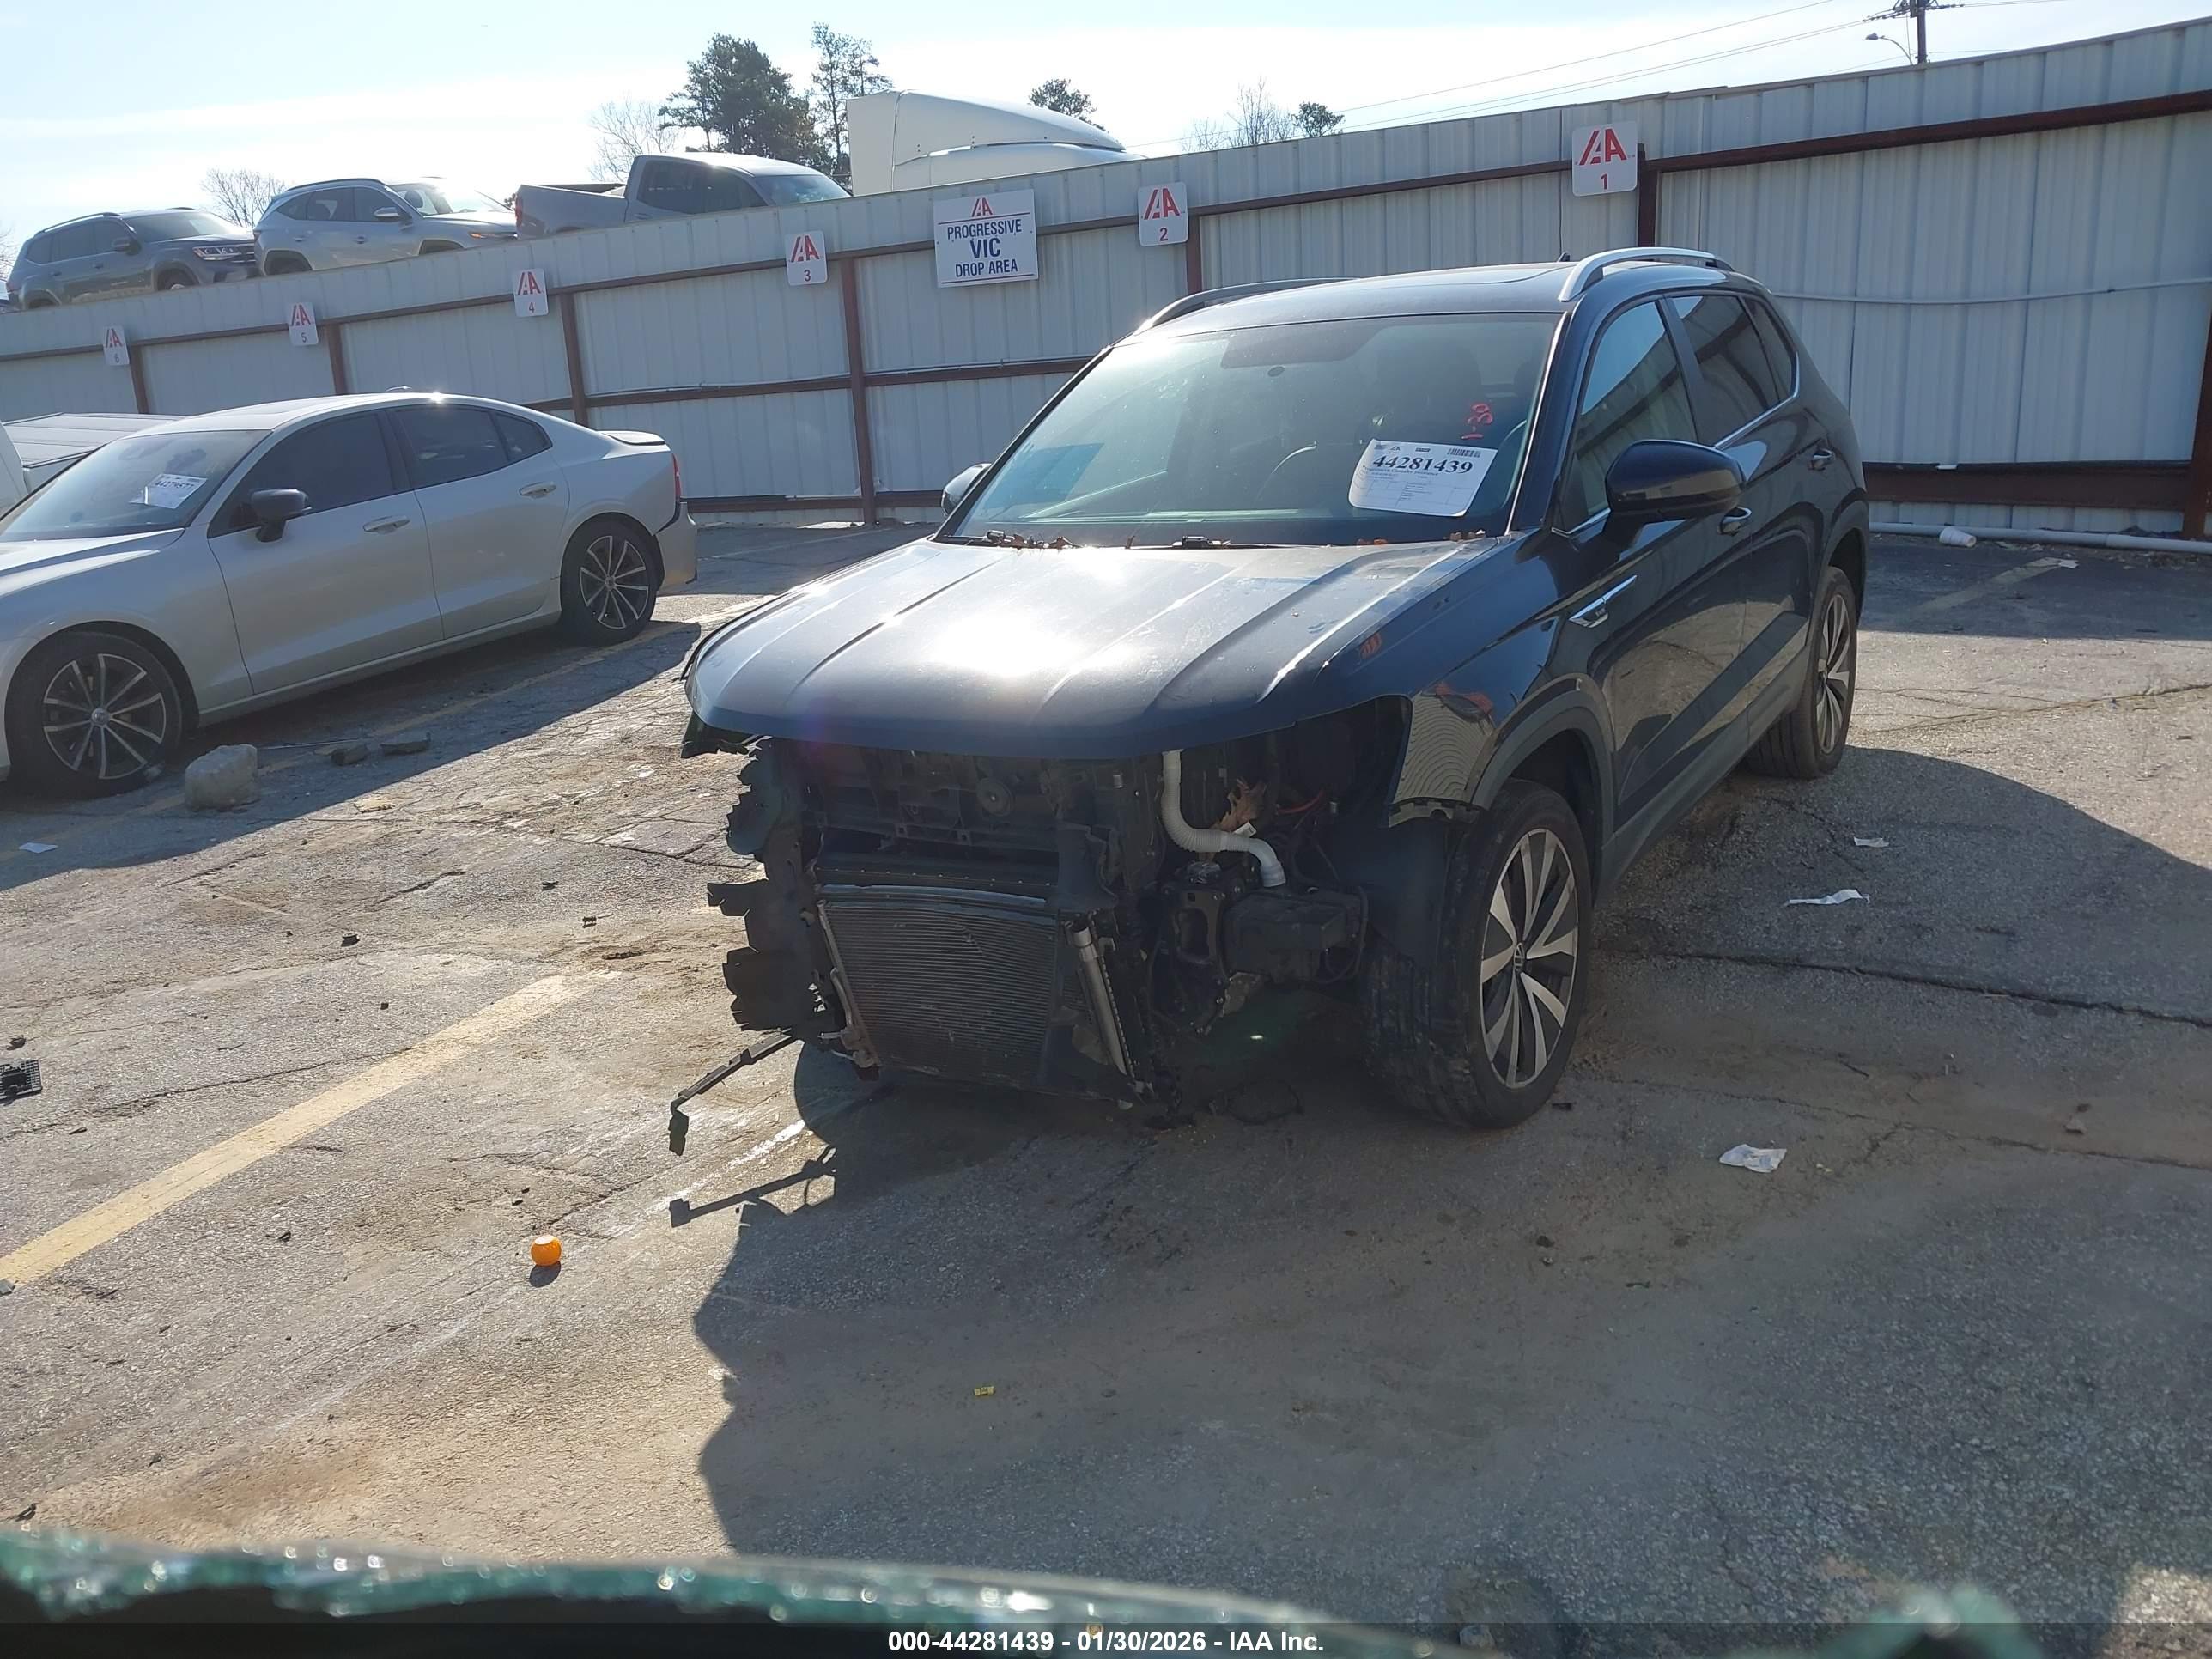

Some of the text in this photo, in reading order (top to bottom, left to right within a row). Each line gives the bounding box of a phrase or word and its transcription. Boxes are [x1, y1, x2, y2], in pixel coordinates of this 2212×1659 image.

[1600, 173, 1608, 190] 1
[947, 219, 1022, 240] PROGRESSIVE
[1159, 227, 1169, 241] 2
[969, 237, 1001, 258] VIC
[955, 258, 1018, 277] DROP AREA
[804, 269, 811, 282] 3
[528, 301, 535, 313] 4
[301, 332, 307, 343] 5
[113, 353, 120, 363] 6
[1373, 455, 1474, 474] 44281439
